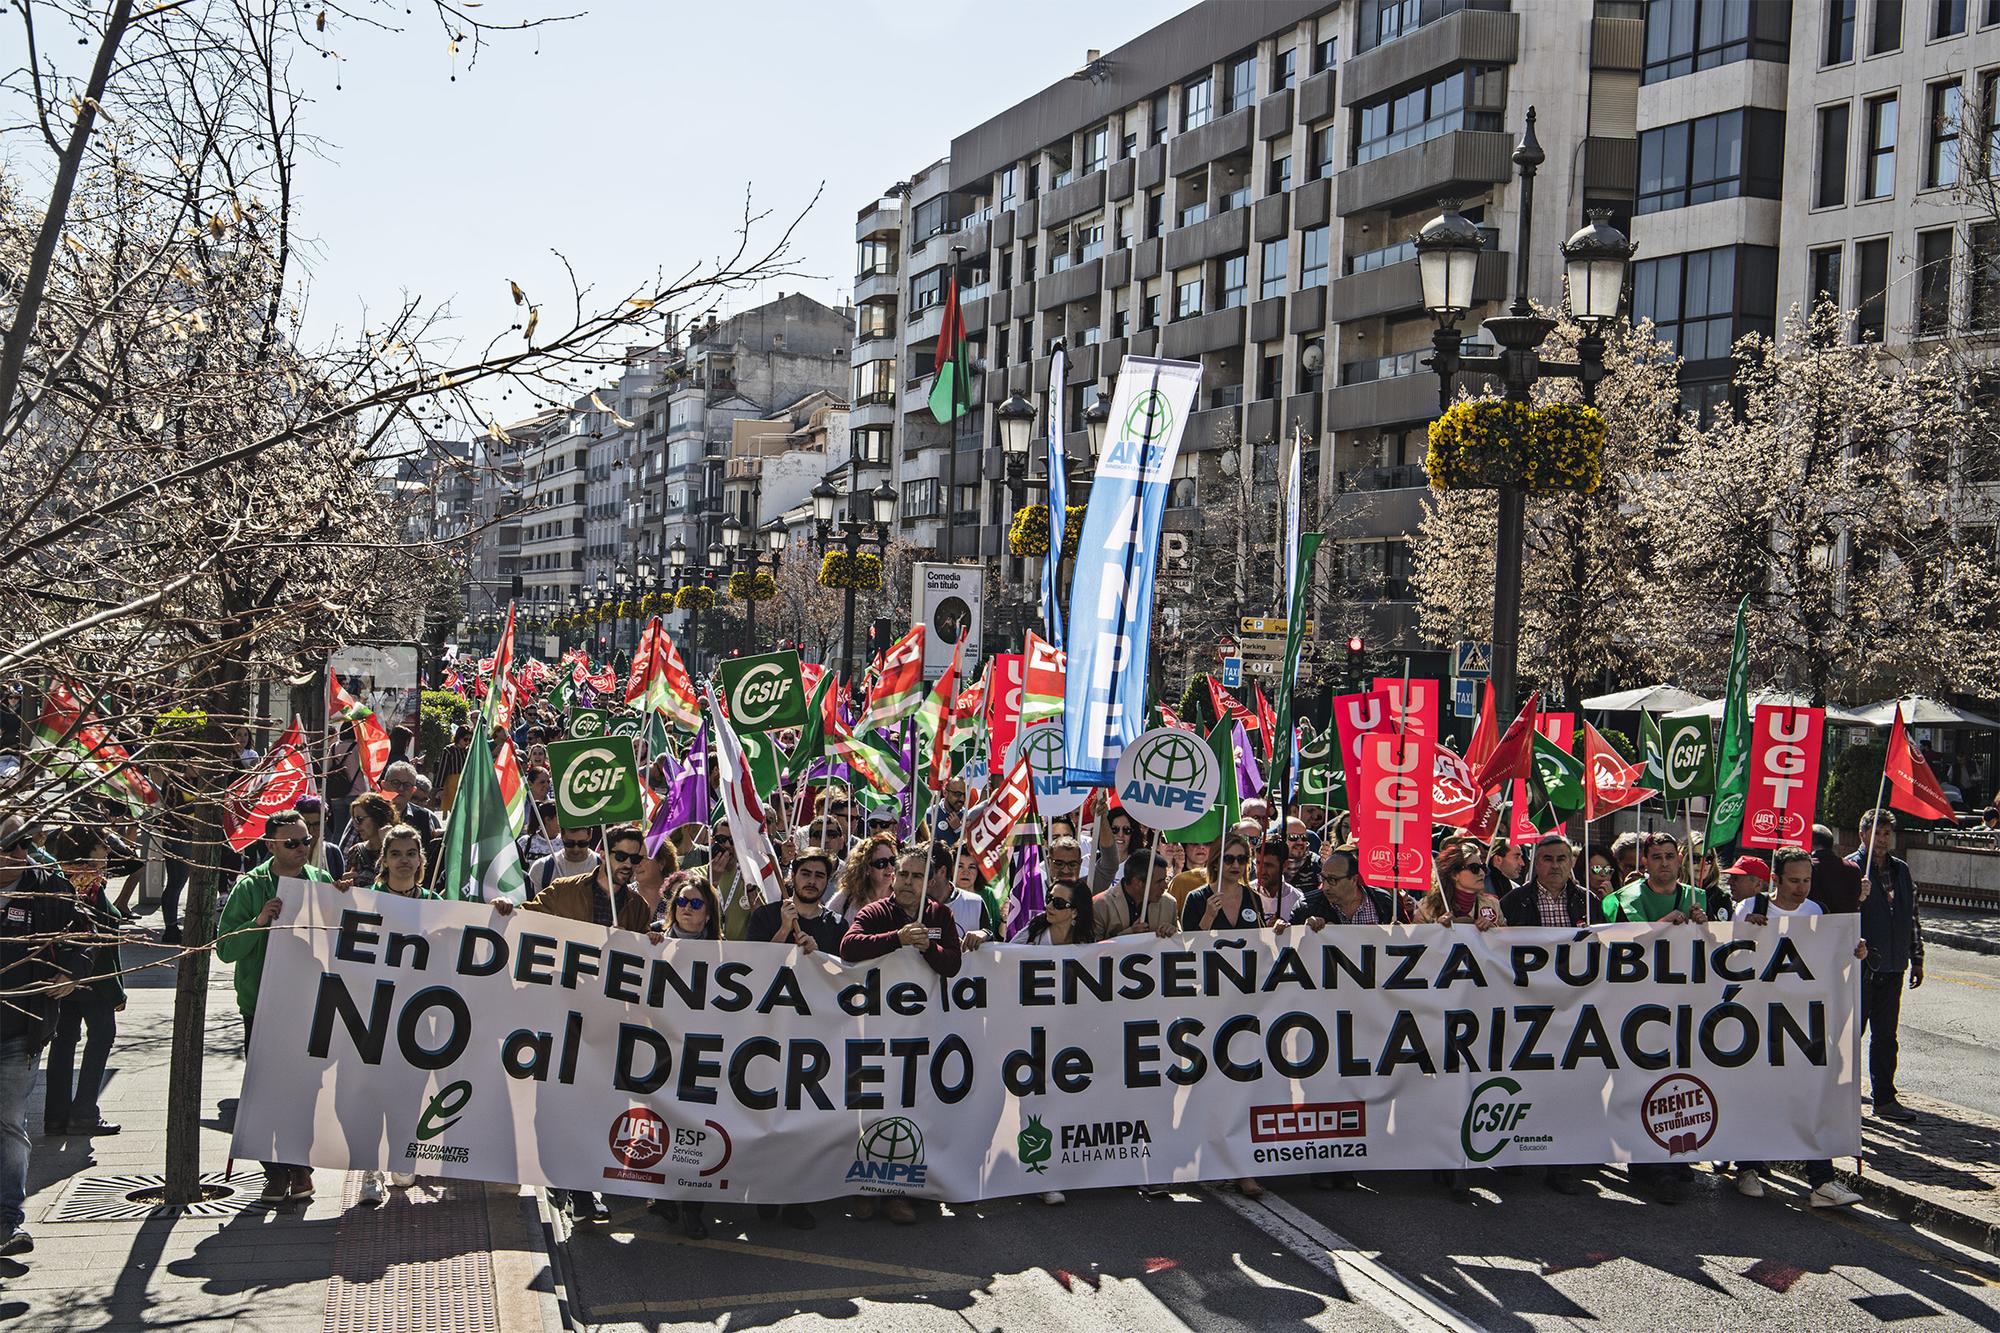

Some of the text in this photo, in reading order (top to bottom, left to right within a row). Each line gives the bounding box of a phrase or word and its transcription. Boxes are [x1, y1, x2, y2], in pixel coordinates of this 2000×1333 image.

[1107, 441, 1167, 469] ANPE
[927, 571, 961, 581] Comedia
[1087, 495, 1144, 760] ANPE
[1242, 643, 1266, 651] Parking
[744, 678, 794, 706] CSIF
[577, 719, 603, 731] CSIF
[1674, 743, 1708, 769] CSIF
[1762, 712, 1811, 809] UGT
[572, 766, 627, 795] CSIF
[1374, 740, 1420, 844] UGT
[1120, 781, 1207, 814] ANPE
[1755, 813, 1775, 825] UGT
[1371, 850, 1391, 862] UGT
[334, 909, 1816, 1017] En DEFENSA de la ENSEÑANZA PÚBLICA
[308, 972, 1827, 1112] NO al DECRETO de ESCOLARIZACIÓN
[1649, 1088, 1705, 1117] FRENTE
[1256, 1110, 1338, 1135] CCOO
[1472, 1102, 1533, 1133] CSIF
[1653, 1111, 1712, 1134] ESTUDIANTES
[1674, 1111, 1684, 1119] de
[616, 1116, 664, 1145] UGT
[1061, 1119, 1152, 1150] FAMPA
[1513, 1134, 1554, 1143] Granada
[405, 1150, 469, 1164] EN MOVIMIENTO
[407, 1142, 470, 1156] ESTUDIANTES
[673, 1146, 704, 1158] Servicios
[1061, 1145, 1152, 1165] ALHAMBRA
[1253, 1141, 1368, 1164] enseñanza
[1519, 1144, 1548, 1152] Educación
[671, 1154, 701, 1166] Públicos
[616, 1169, 653, 1182] Andalucía
[677, 1178, 713, 1189] Granada
[845, 1160, 928, 1184] ANPE
[877, 1179, 925, 1188] INDEPENDIENTE
[859, 1185, 906, 1196] ANDALUCÍA
